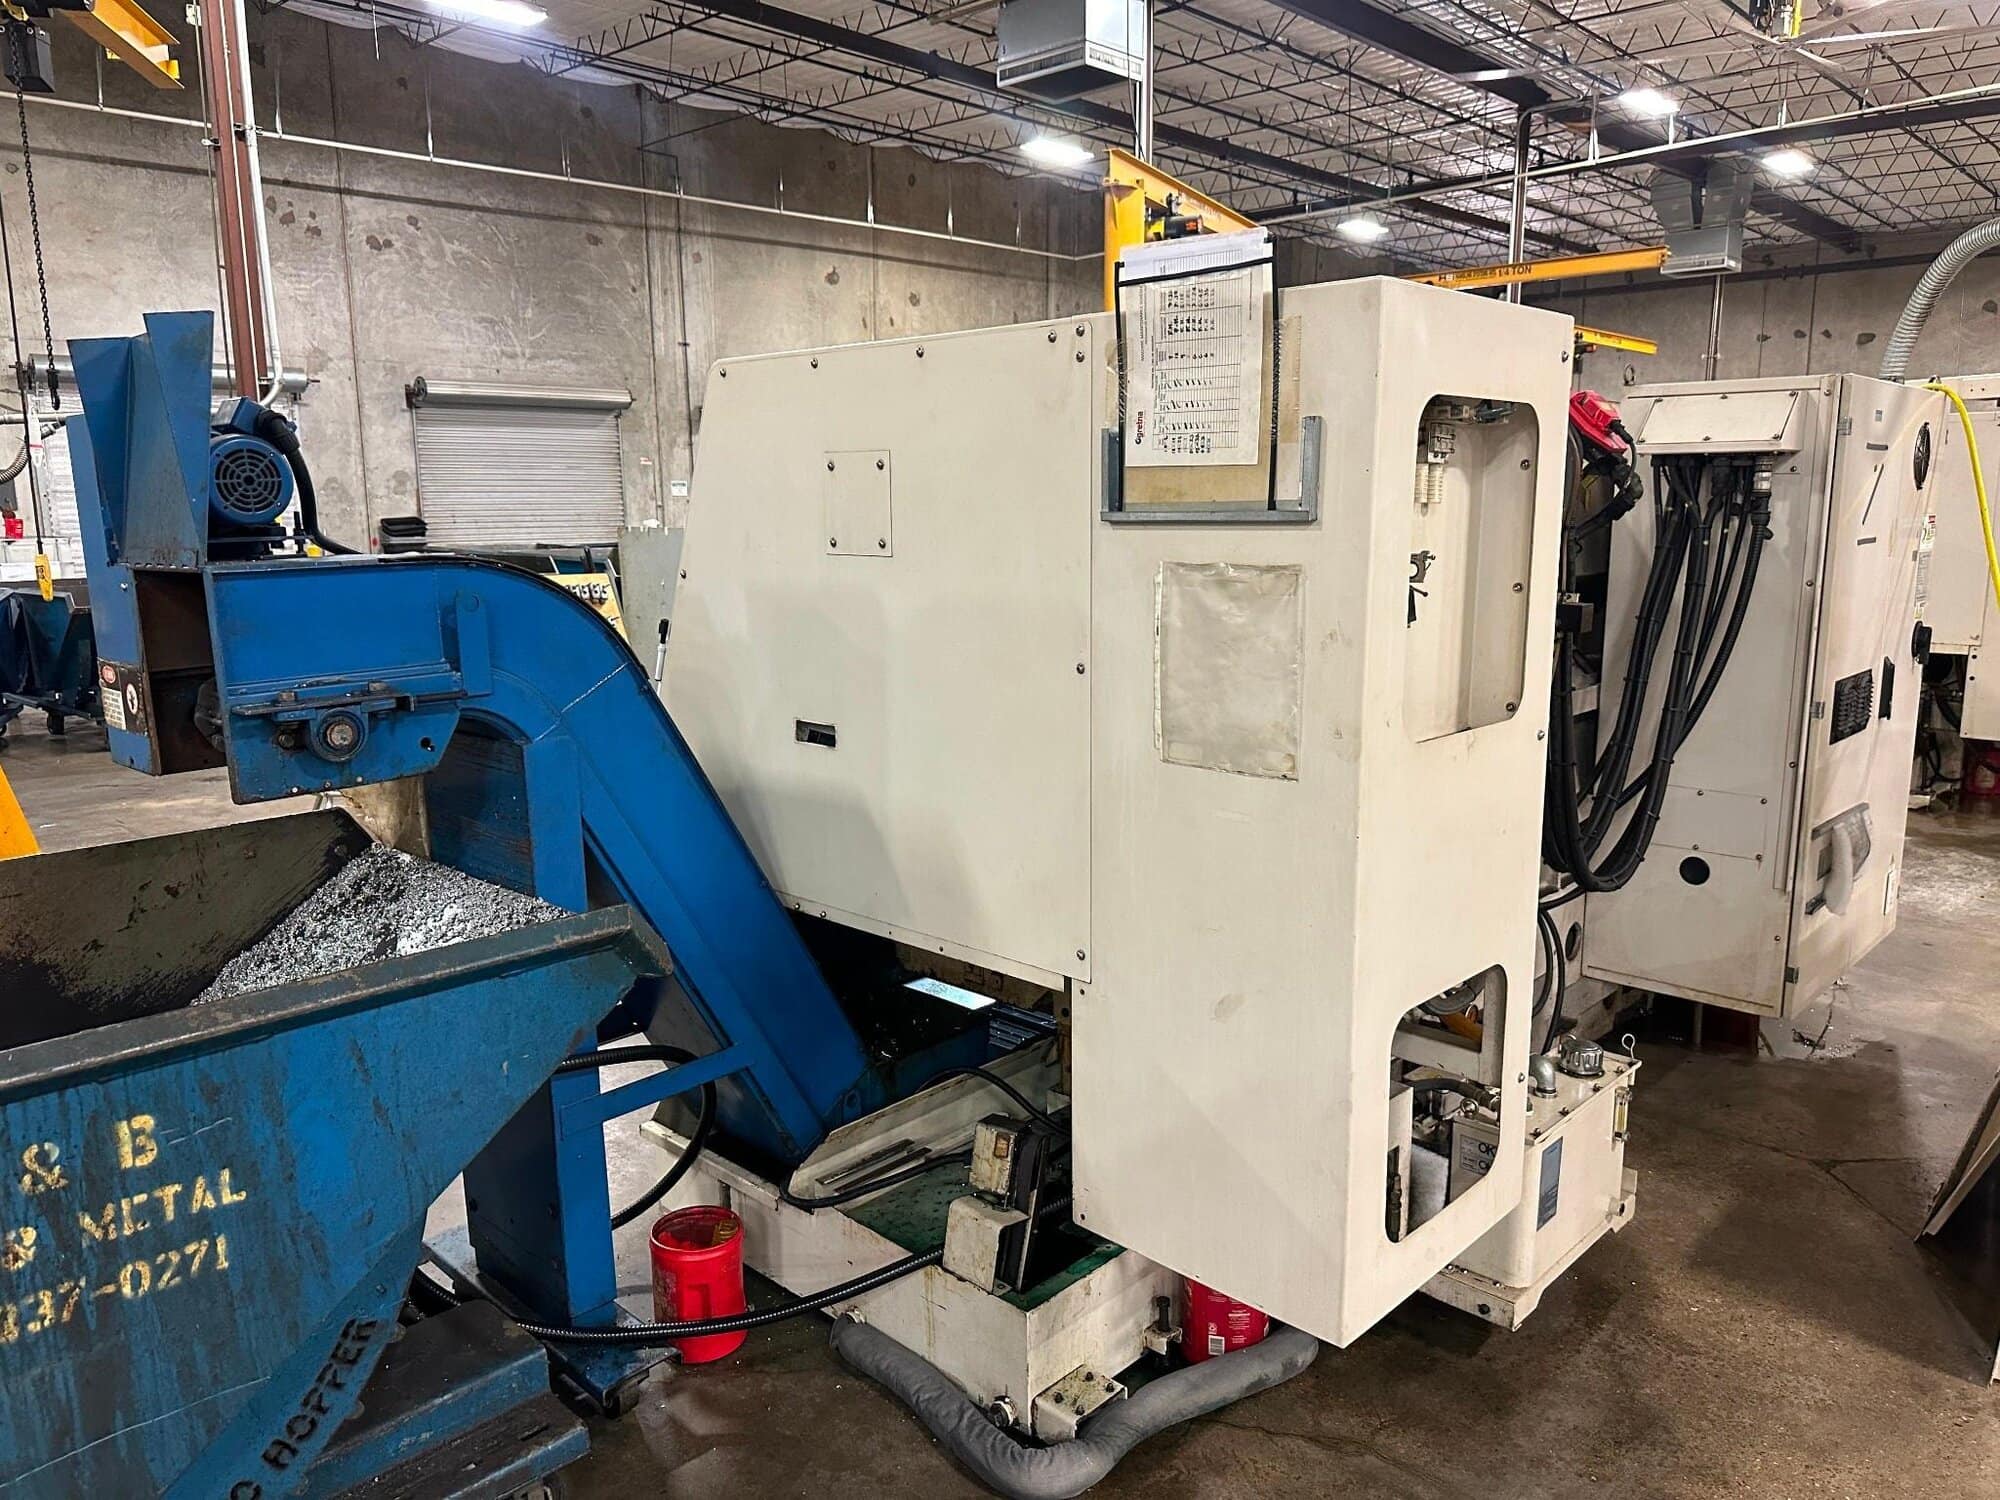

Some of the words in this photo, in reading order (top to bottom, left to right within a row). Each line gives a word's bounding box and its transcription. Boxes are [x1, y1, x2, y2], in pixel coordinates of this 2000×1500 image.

[1511, 263, 1532, 276] TON
[115, 1115, 157, 1169] B
[79, 1168, 247, 1241] METAL
